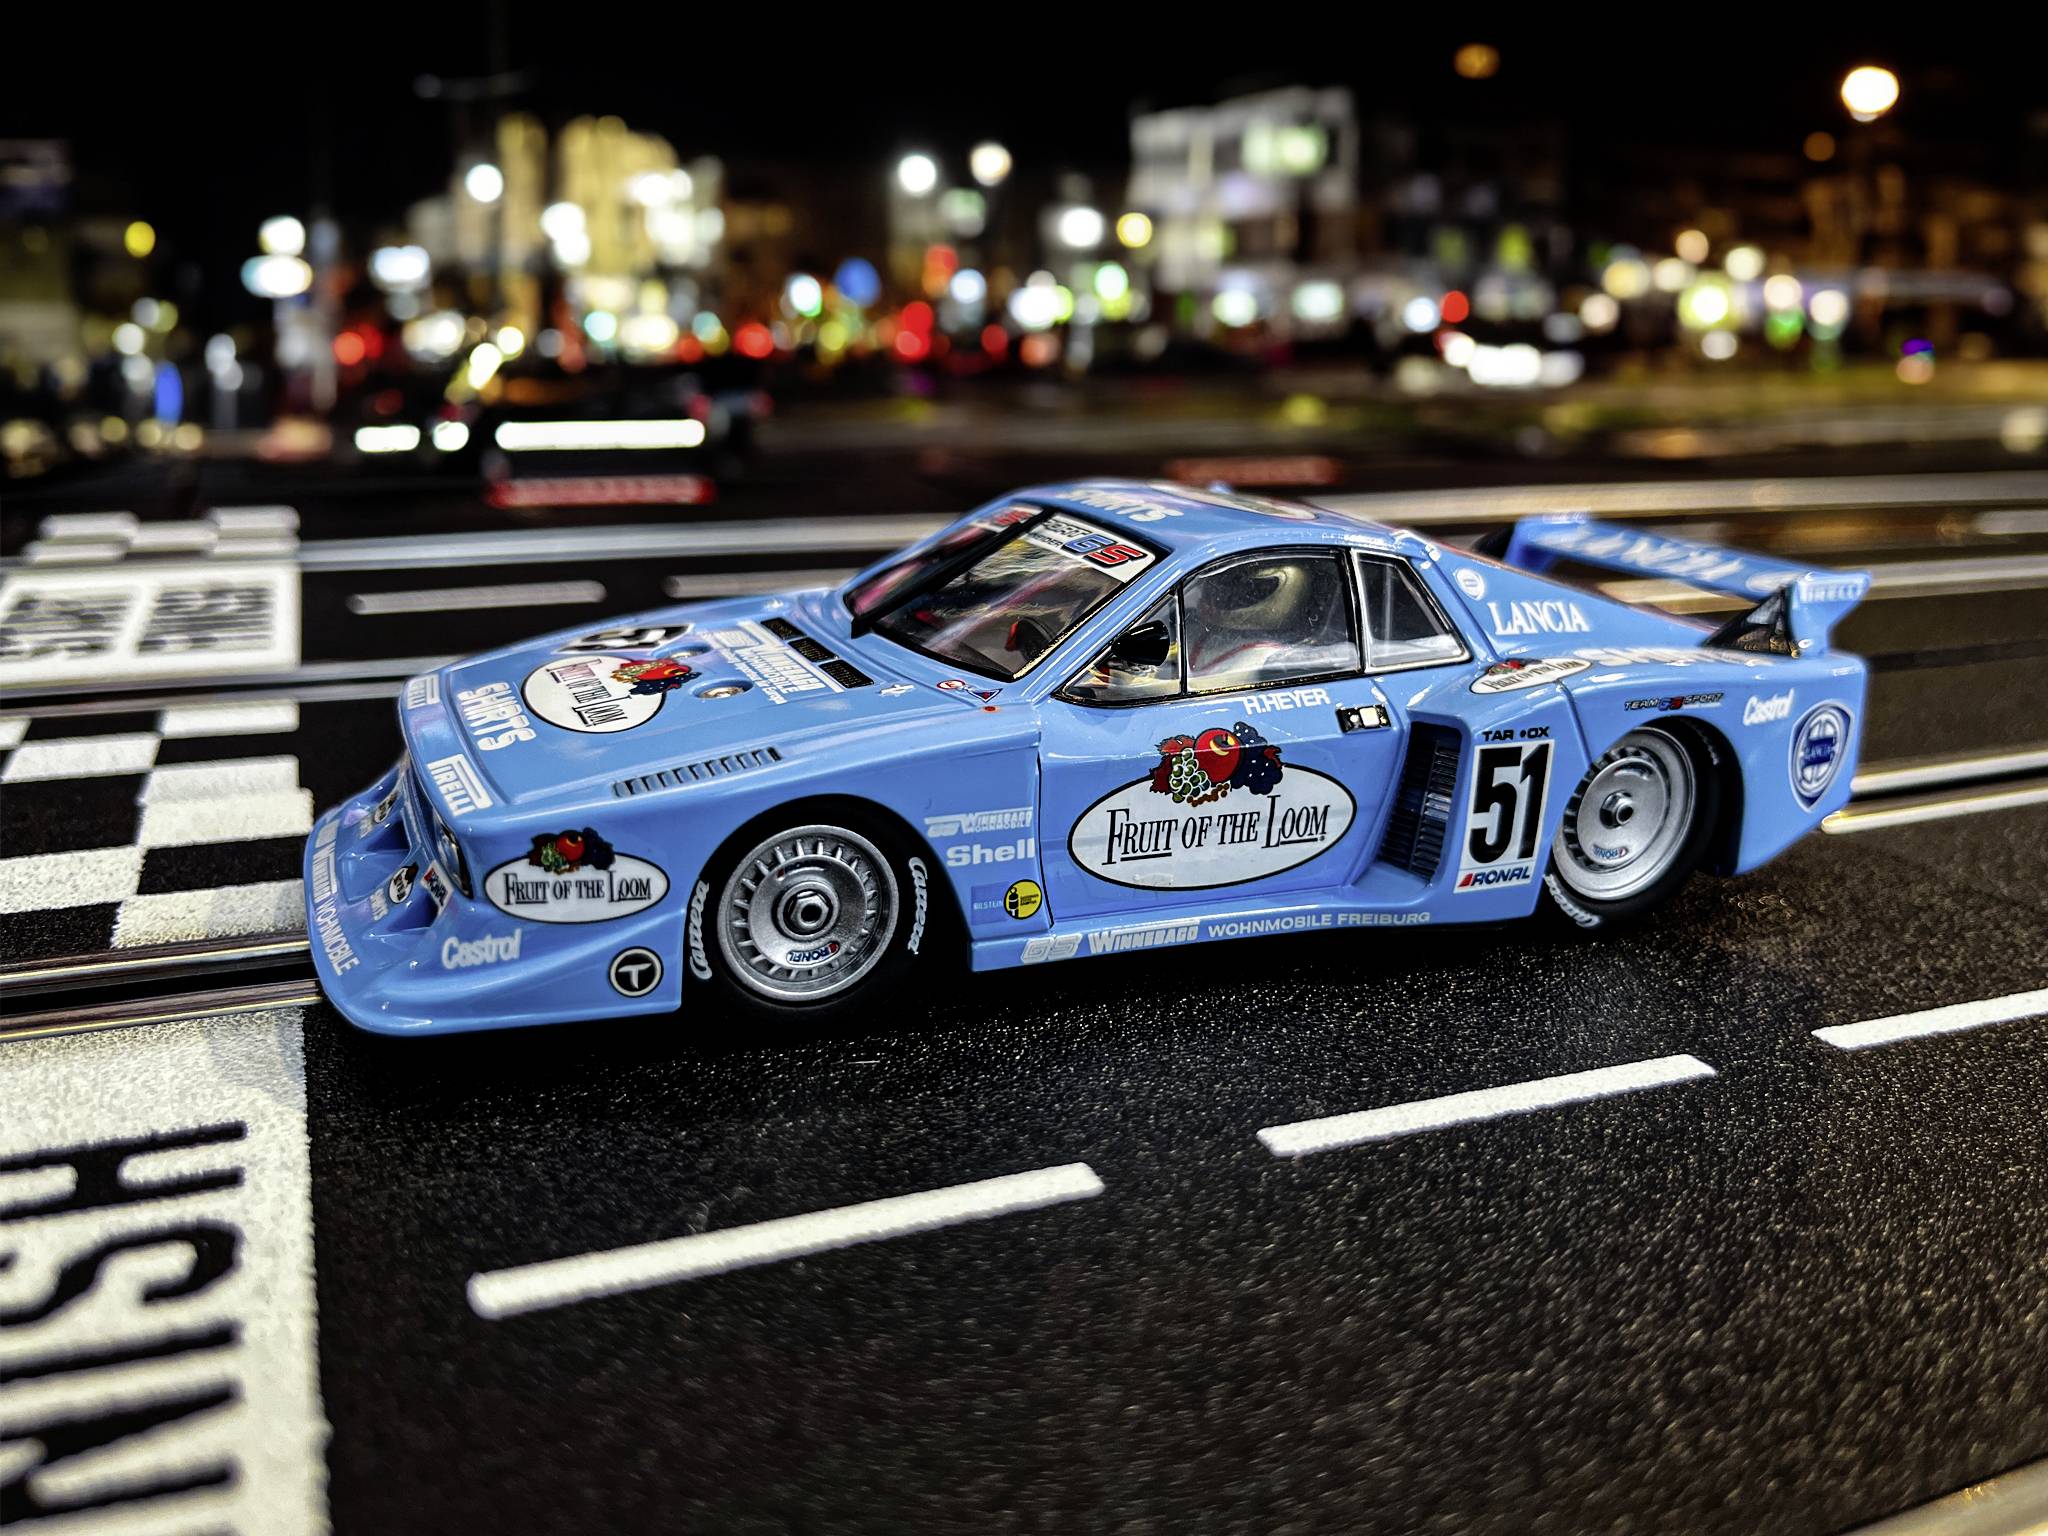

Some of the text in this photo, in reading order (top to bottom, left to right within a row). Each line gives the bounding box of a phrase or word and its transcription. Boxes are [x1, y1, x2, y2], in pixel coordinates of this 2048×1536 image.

[1062, 533, 1148, 568] GS
[1487, 601, 1591, 636] LANCIA
[457, 682, 537, 751] SHIRTS
[571, 695, 632, 727] LOOM
[1624, 698, 1660, 711] TEAM
[1683, 692, 1725, 706] SPORT
[1743, 688, 1796, 727] Castrol
[427, 754, 494, 816] PIRELLI
[1469, 743, 1551, 864] 51
[946, 837, 1036, 868] Shell
[1102, 808, 1178, 866] FRUIT
[1181, 816, 1213, 849] OF
[1217, 811, 1260, 845] THE
[503, 870, 652, 906] FRUIT OF THE LOOM
[1471, 866, 1531, 888] RONAL
[908, 856, 928, 955] Carrera
[315, 898, 361, 977] WOHNMOBILE
[441, 927, 523, 971] Castrol
[689, 879, 713, 981] Carrera
[1088, 919, 1199, 955] WINNEBAGO
[1207, 911, 1333, 938] WOHNMOBILE
[1336, 910, 1432, 927] FREIBURG
[0, 1119, 248, 1536] NISH
